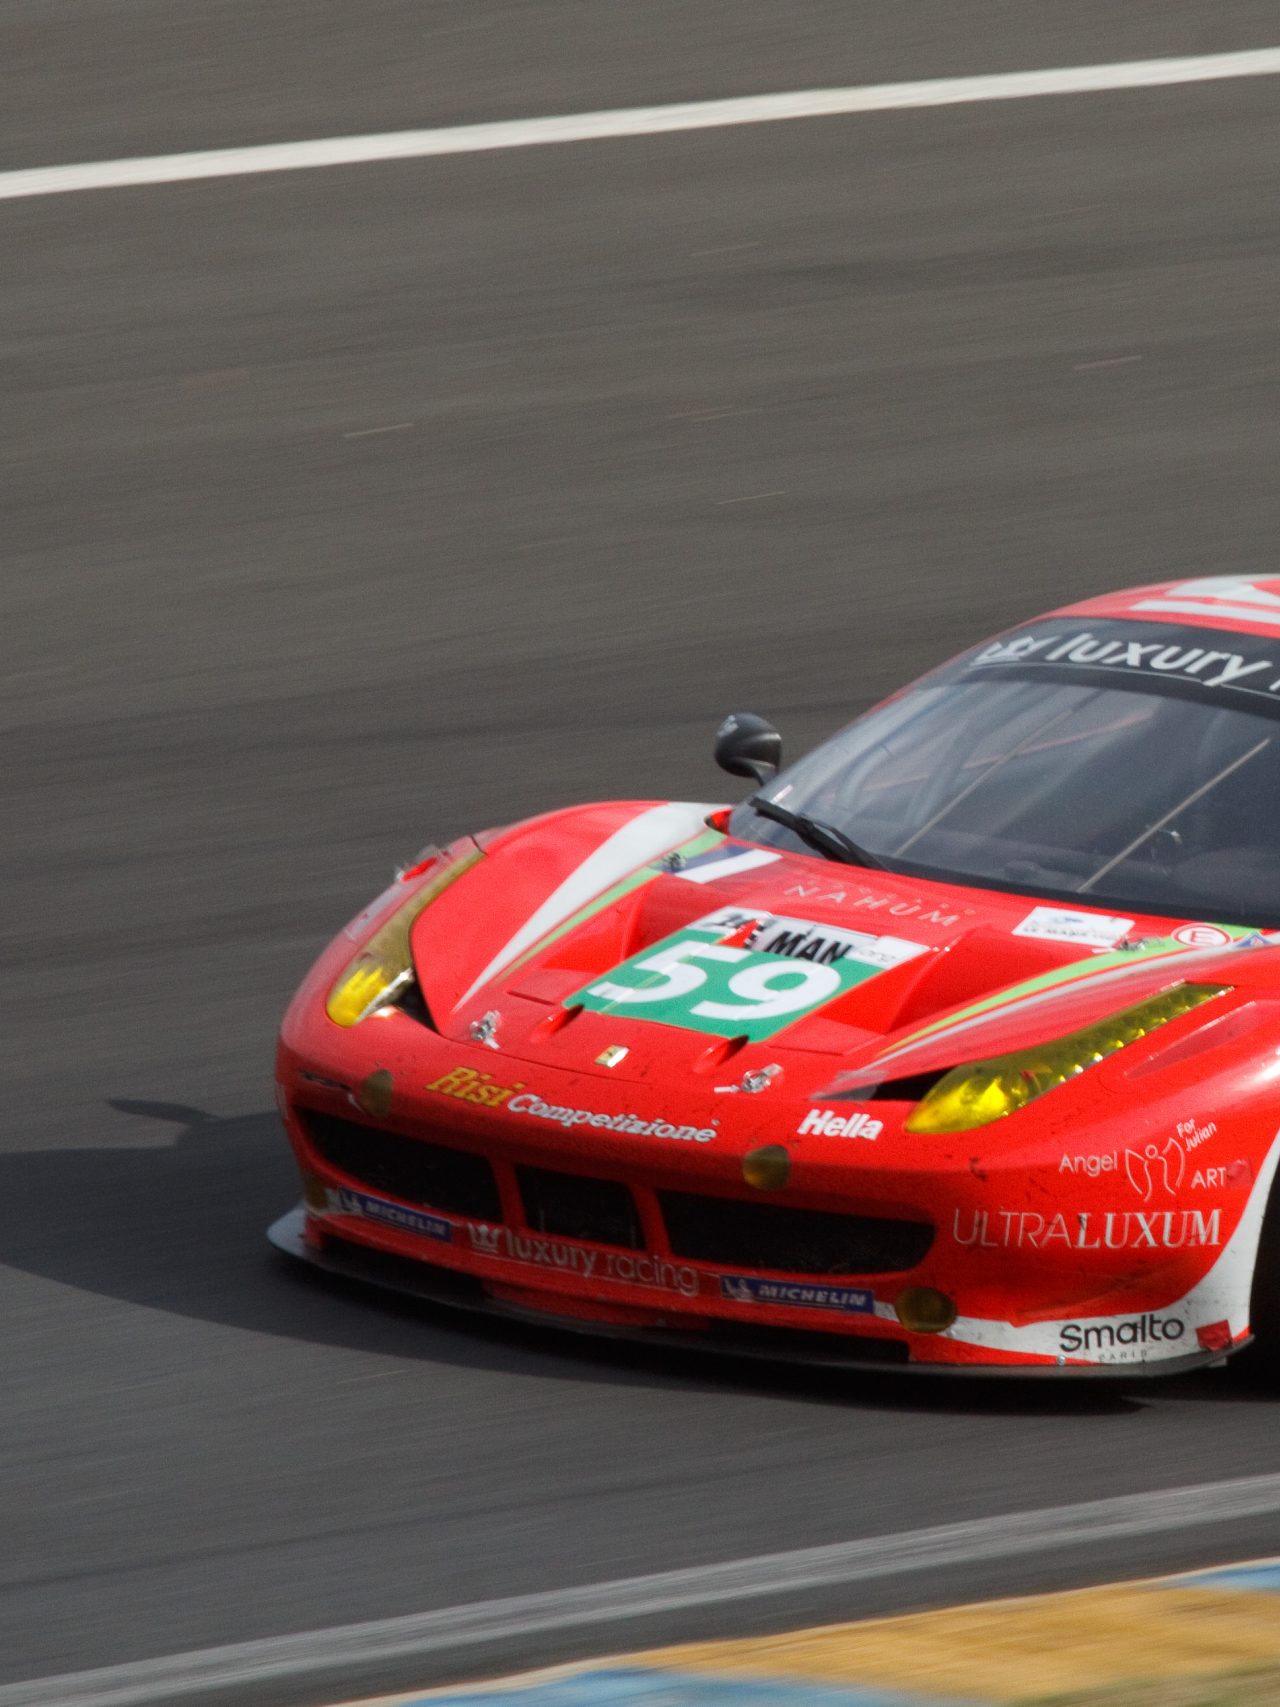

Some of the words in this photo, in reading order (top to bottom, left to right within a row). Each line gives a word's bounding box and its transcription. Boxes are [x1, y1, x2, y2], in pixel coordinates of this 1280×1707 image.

[1051, 631, 1274, 686] luxury
[587, 940, 841, 1020] 59
[424, 1066, 524, 1108] Risi
[507, 1094, 717, 1142] Competizione
[797, 1109, 884, 1141] Hella
[1176, 1118, 1196, 1138] For
[1186, 1122, 1218, 1152] Julian
[1058, 1152, 1118, 1176] Angel
[1190, 1167, 1227, 1190] ART
[366, 1201, 446, 1237] MICHELIN
[953, 1208, 1223, 1249] ULTRALUXUM
[503, 1229, 597, 1277] luxury
[607, 1251, 700, 1296] racing
[758, 1284, 868, 1307] MICHELIN
[1060, 1314, 1184, 1352] Smalto
